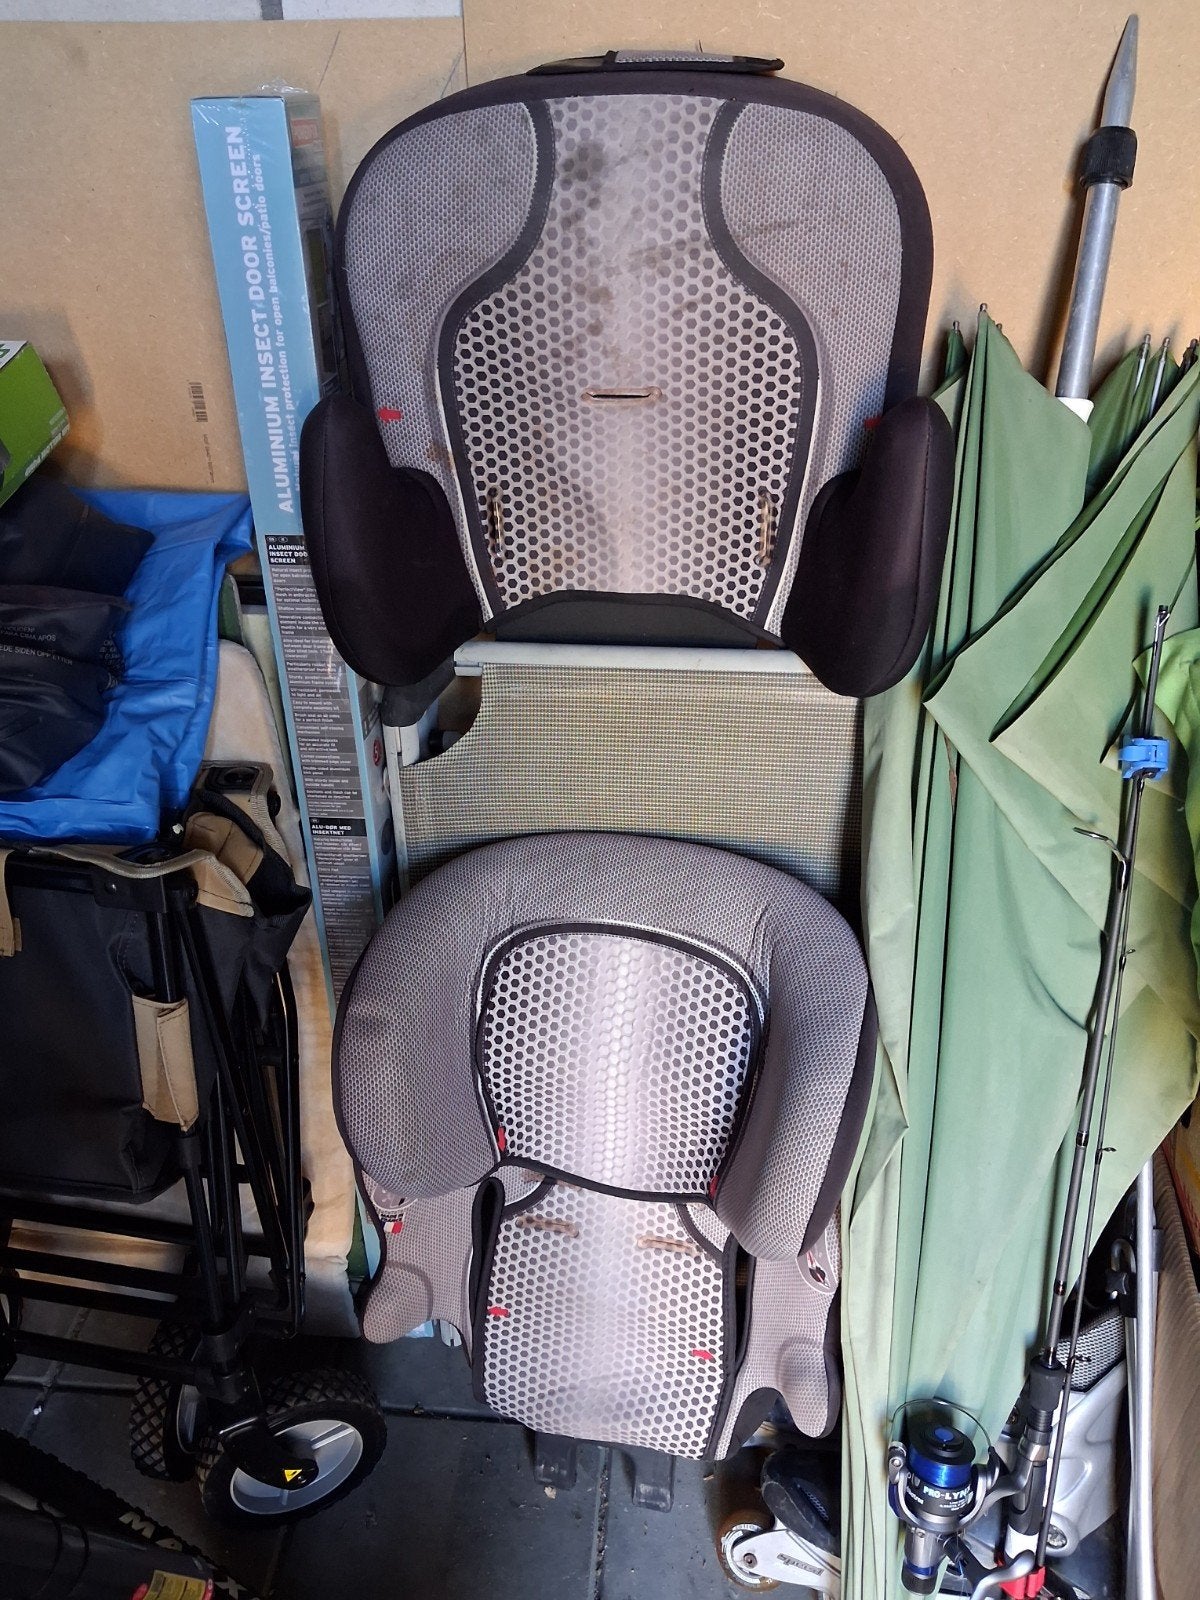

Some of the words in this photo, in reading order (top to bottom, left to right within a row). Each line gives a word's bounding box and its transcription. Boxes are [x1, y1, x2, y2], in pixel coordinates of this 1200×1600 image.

[225, 126, 254, 227] SCREEN
[252, 154, 265, 192] doors
[241, 235, 265, 301] DOOR
[270, 295, 283, 326] open
[276, 329, 286, 348] for
[251, 309, 277, 389] INSECT
[279, 351, 295, 410] protection
[264, 397, 293, 513] ALUMINIUM
